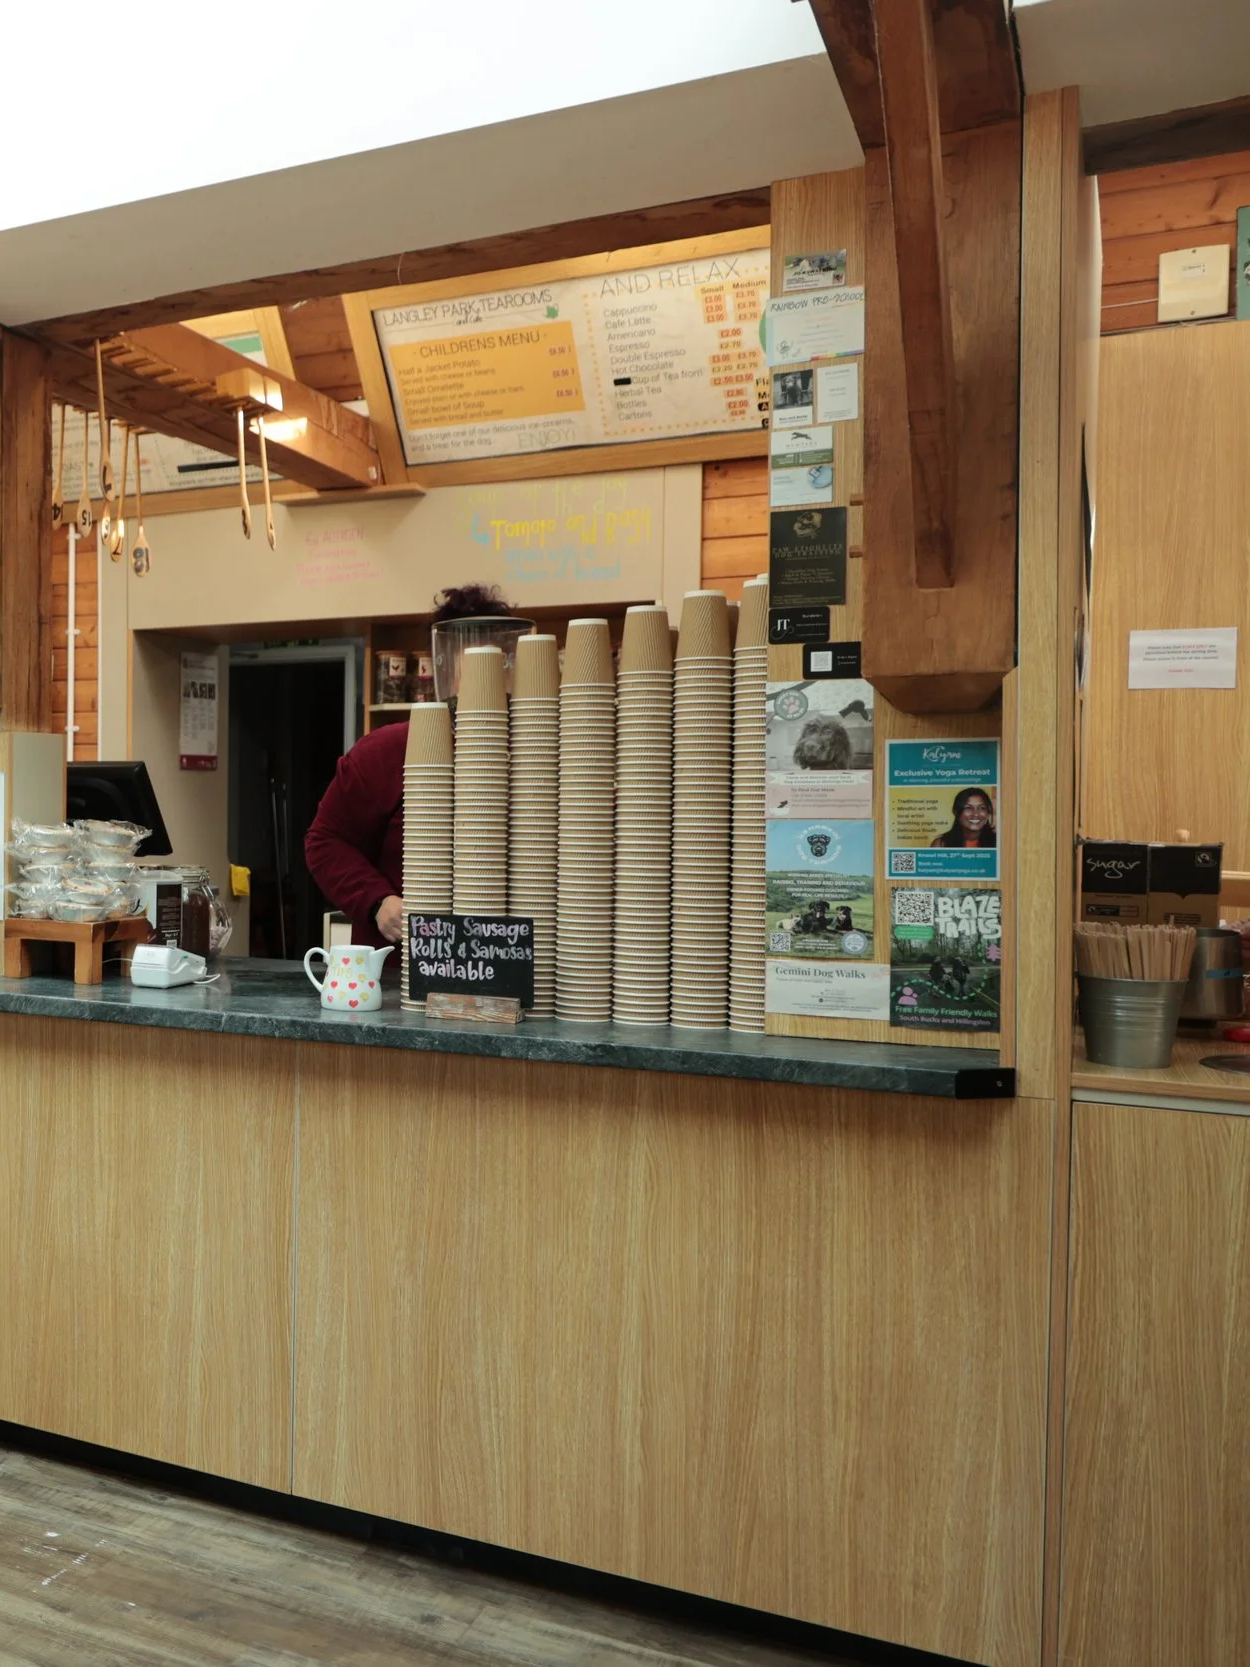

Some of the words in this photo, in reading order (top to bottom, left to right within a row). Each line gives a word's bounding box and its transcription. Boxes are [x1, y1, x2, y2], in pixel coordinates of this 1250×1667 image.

[600, 273, 651, 299] AND
[658, 256, 741, 290] RELAX
[732, 279, 767, 290] Medium
[383, 304, 438, 327] LANGLEY
[441, 300, 477, 319] PARK
[479, 288, 553, 314] TEAROOMS
[603, 303, 657, 318] Cappuccino
[628, 315, 652, 326] Latte
[607, 328, 656, 341] Americano
[609, 340, 650, 353] Espresso
[719, 327, 741, 338] £2.00
[420, 336, 496, 359] CHILDRENS
[500, 330, 541, 347] MENU
[611, 353, 642, 365] Double
[643, 348, 686, 362] Espresso
[426, 362, 451, 373] Jacket
[452, 359, 481, 370] Potato
[611, 365, 628, 376] Hot
[629, 360, 674, 374] Chocolate
[632, 374, 650, 385] Cup
[651, 373, 661, 381] of
[663, 371, 680, 381] Tea
[680, 369, 704, 379] from
[646, 386, 662, 395] Tea
[616, 400, 648, 411] Bottles
[618, 411, 653, 422] Cartons
[490, 514, 557, 552] Tomato
[894, 769, 934, 777] Exclusive
[935, 769, 957, 778] Yoga
[958, 768, 991, 776] Retreat
[1086, 858, 1141, 879] sugar
[937, 894, 1002, 919] BLAZE
[410, 915, 456, 945] Pastry
[462, 916, 530, 945] Sausage
[935, 917, 1002, 940] TRAILS
[410, 937, 452, 960] Rolls
[470, 939, 533, 960] Samosas
[418, 958, 495, 981] available
[775, 966, 811, 976] Gemini
[813, 968, 834, 979] Dog
[835, 969, 866, 979] Walks
[895, 1005, 912, 1013] Free
[913, 1006, 940, 1016] Family
[940, 1007, 973, 1018] Friendly
[973, 1009, 998, 1018] Walks
[899, 1014, 922, 1022] South
